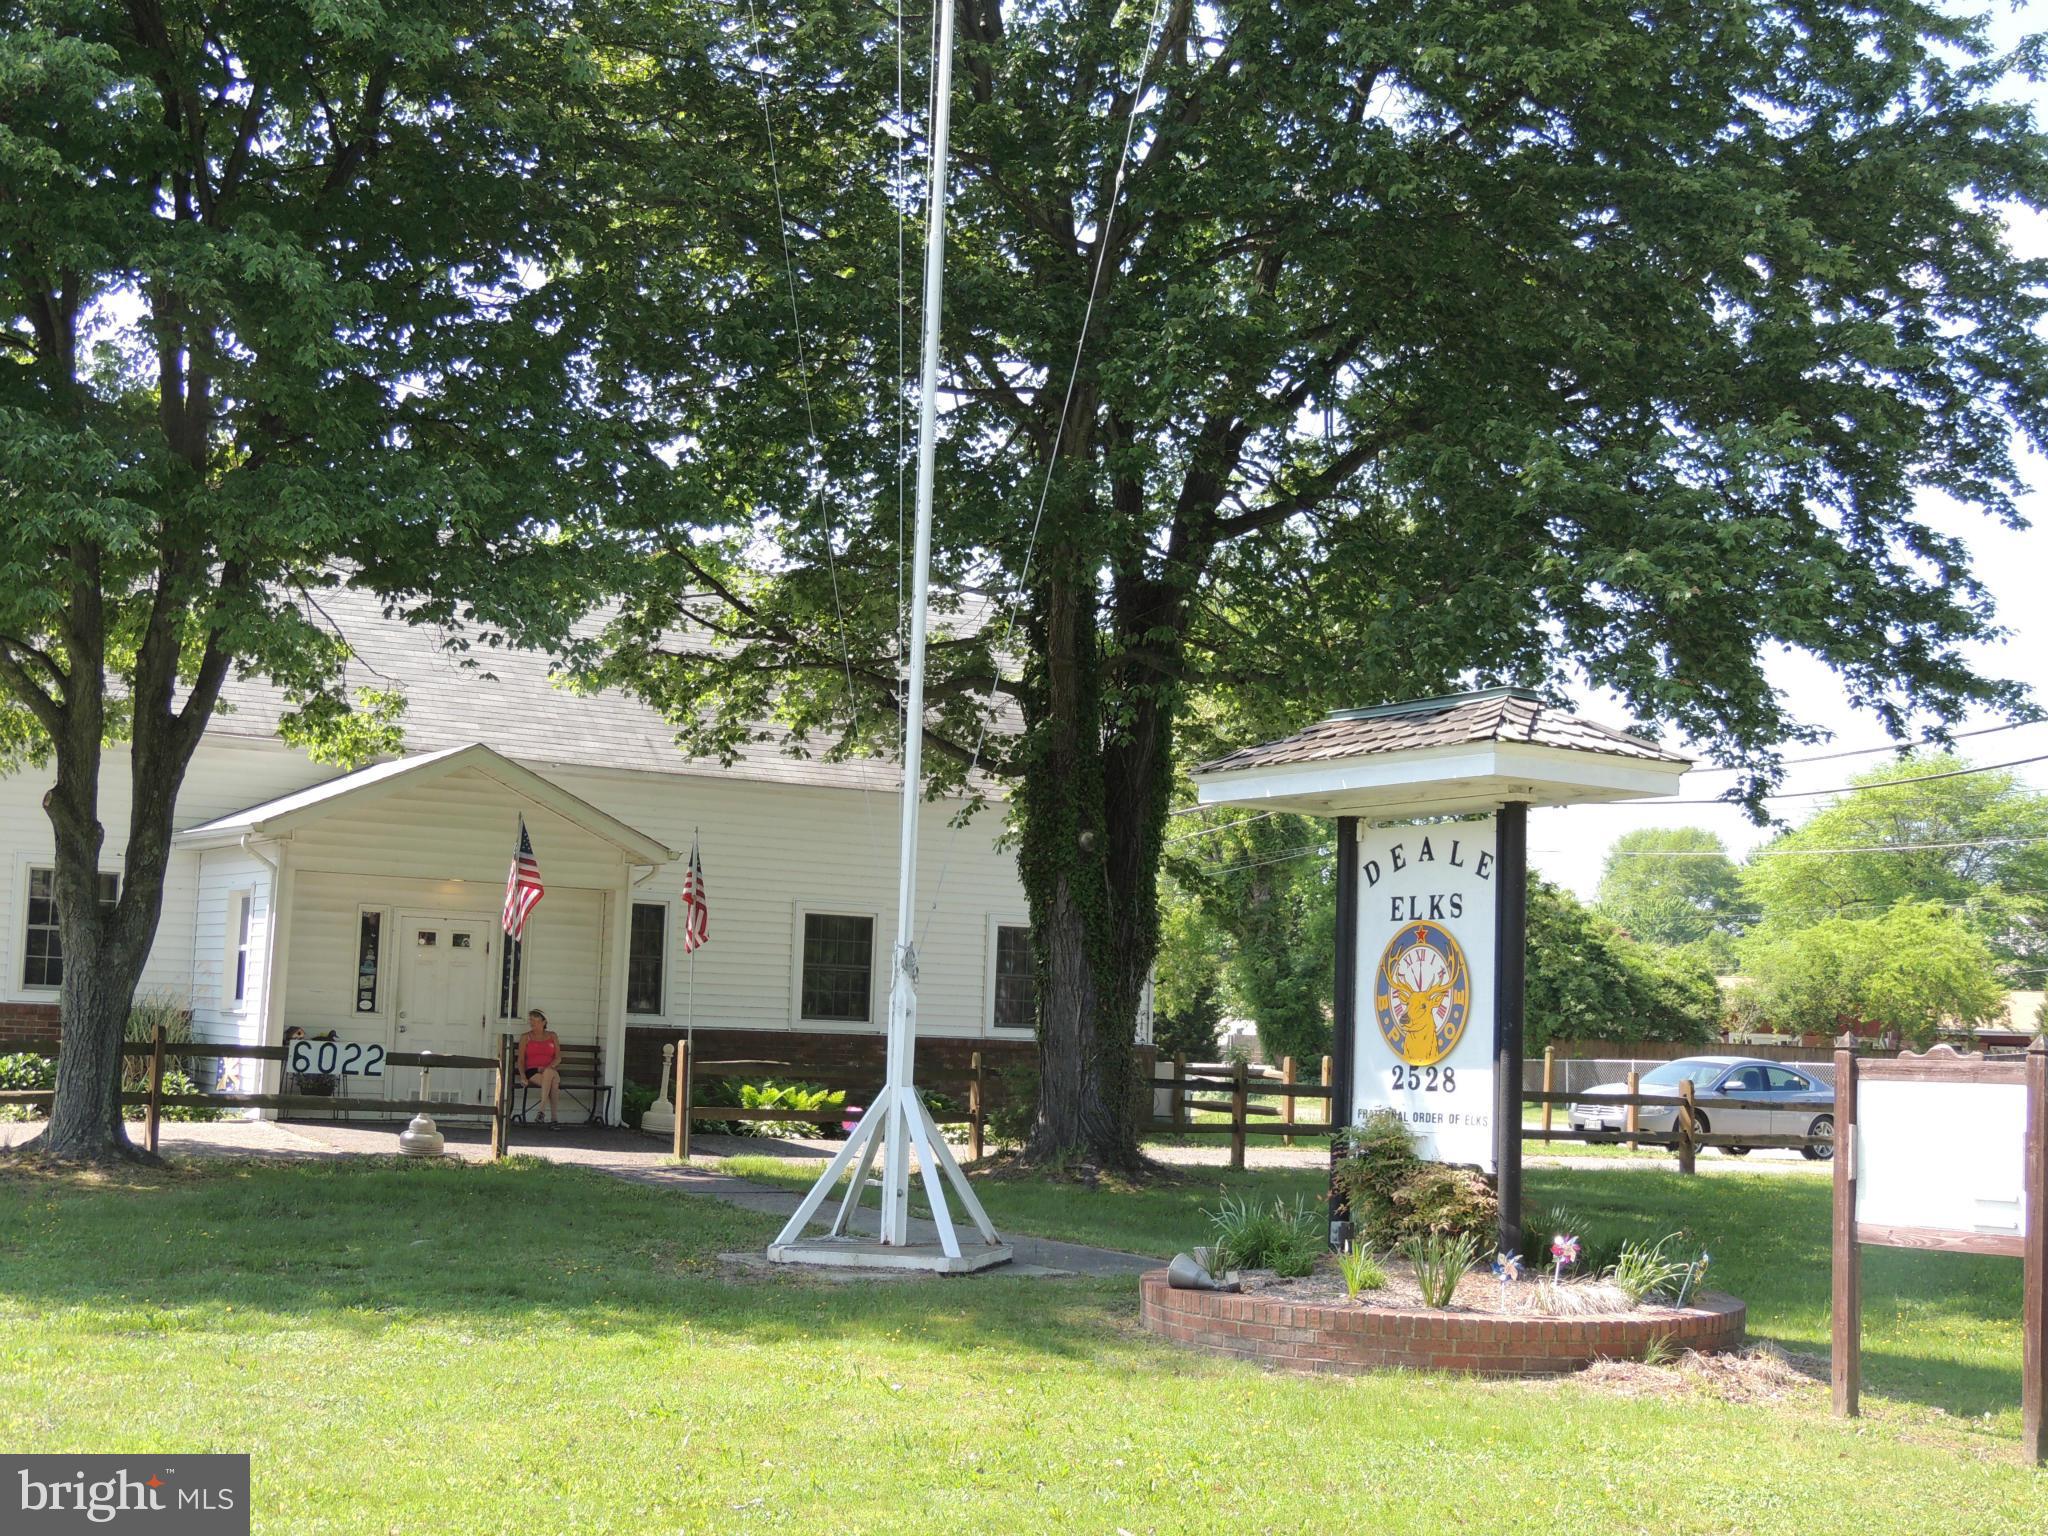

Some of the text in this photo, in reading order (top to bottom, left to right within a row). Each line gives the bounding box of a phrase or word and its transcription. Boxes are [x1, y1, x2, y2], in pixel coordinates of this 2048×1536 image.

[1363, 836, 1494, 888] DEALE
[1390, 893, 1463, 921] ELKS
[292, 1041, 384, 1076] 6022
[1392, 1065, 1456, 1093] 2528
[1413, 1112, 1443, 1124] ORDER
[1449, 1114, 1460, 1125] OF
[1465, 1115, 1488, 1127] ELKS
